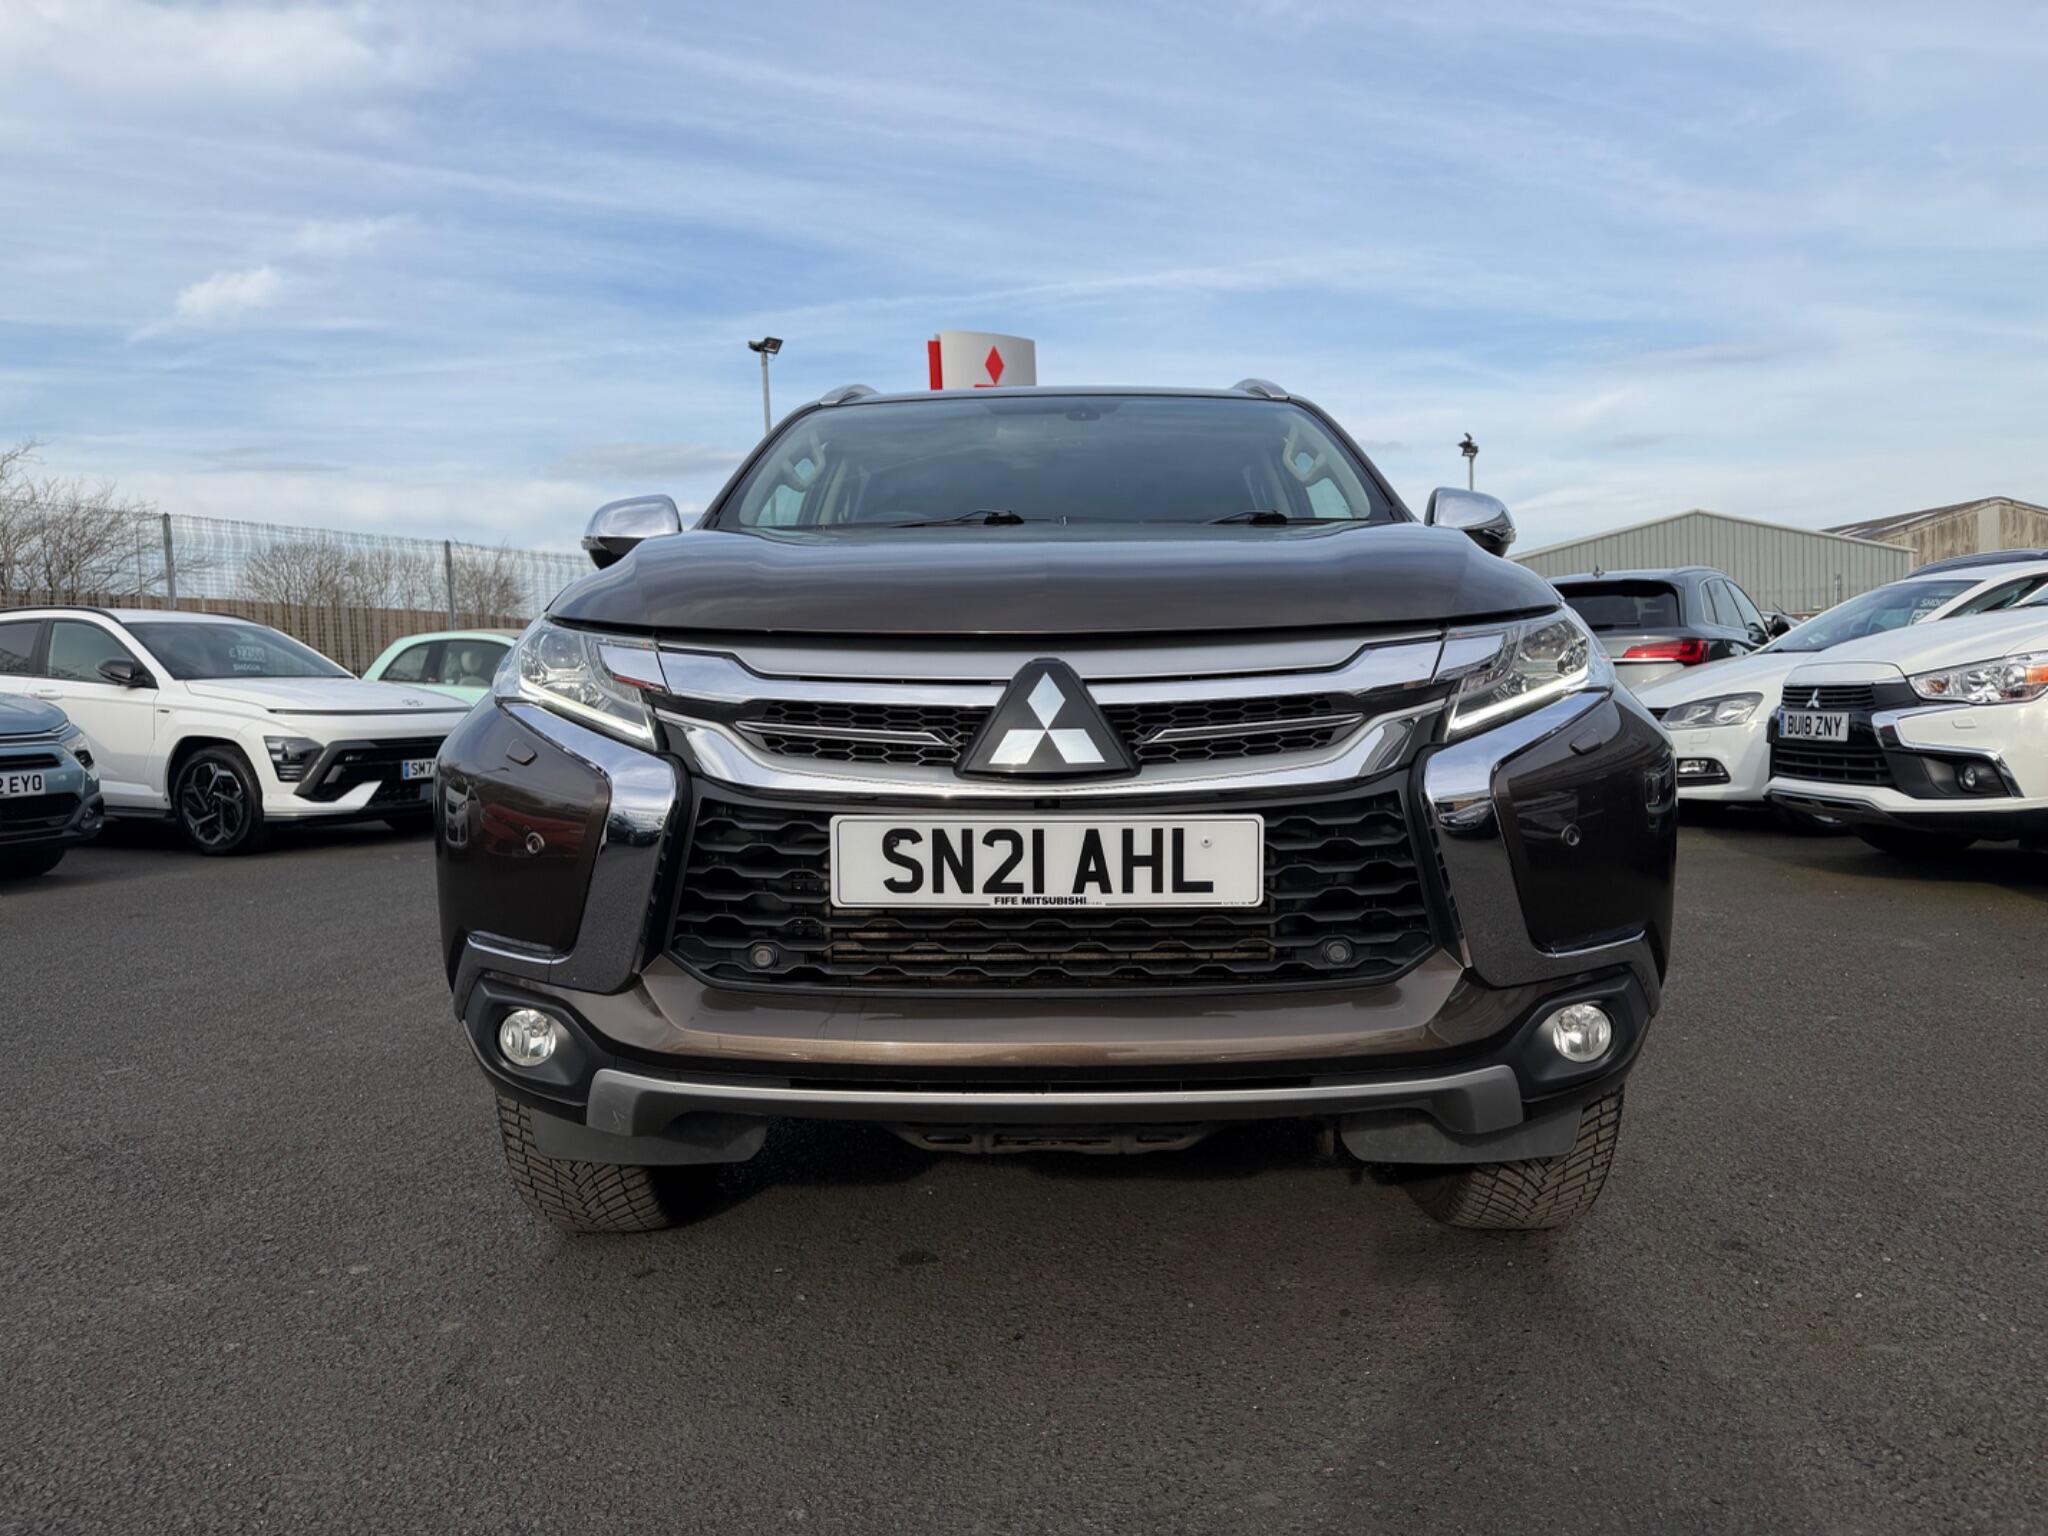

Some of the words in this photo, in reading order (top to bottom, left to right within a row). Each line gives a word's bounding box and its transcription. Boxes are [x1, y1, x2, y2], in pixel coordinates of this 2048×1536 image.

[1787, 714, 1812, 735] BU18
[1815, 716, 1842, 737] ZNY
[9, 775, 42, 793] EYO
[882, 828, 1045, 893] SN21
[1071, 828, 1214, 893] AHL
[994, 896, 1018, 905] FIFE
[1022, 896, 1086, 905] MITSUBISHI
